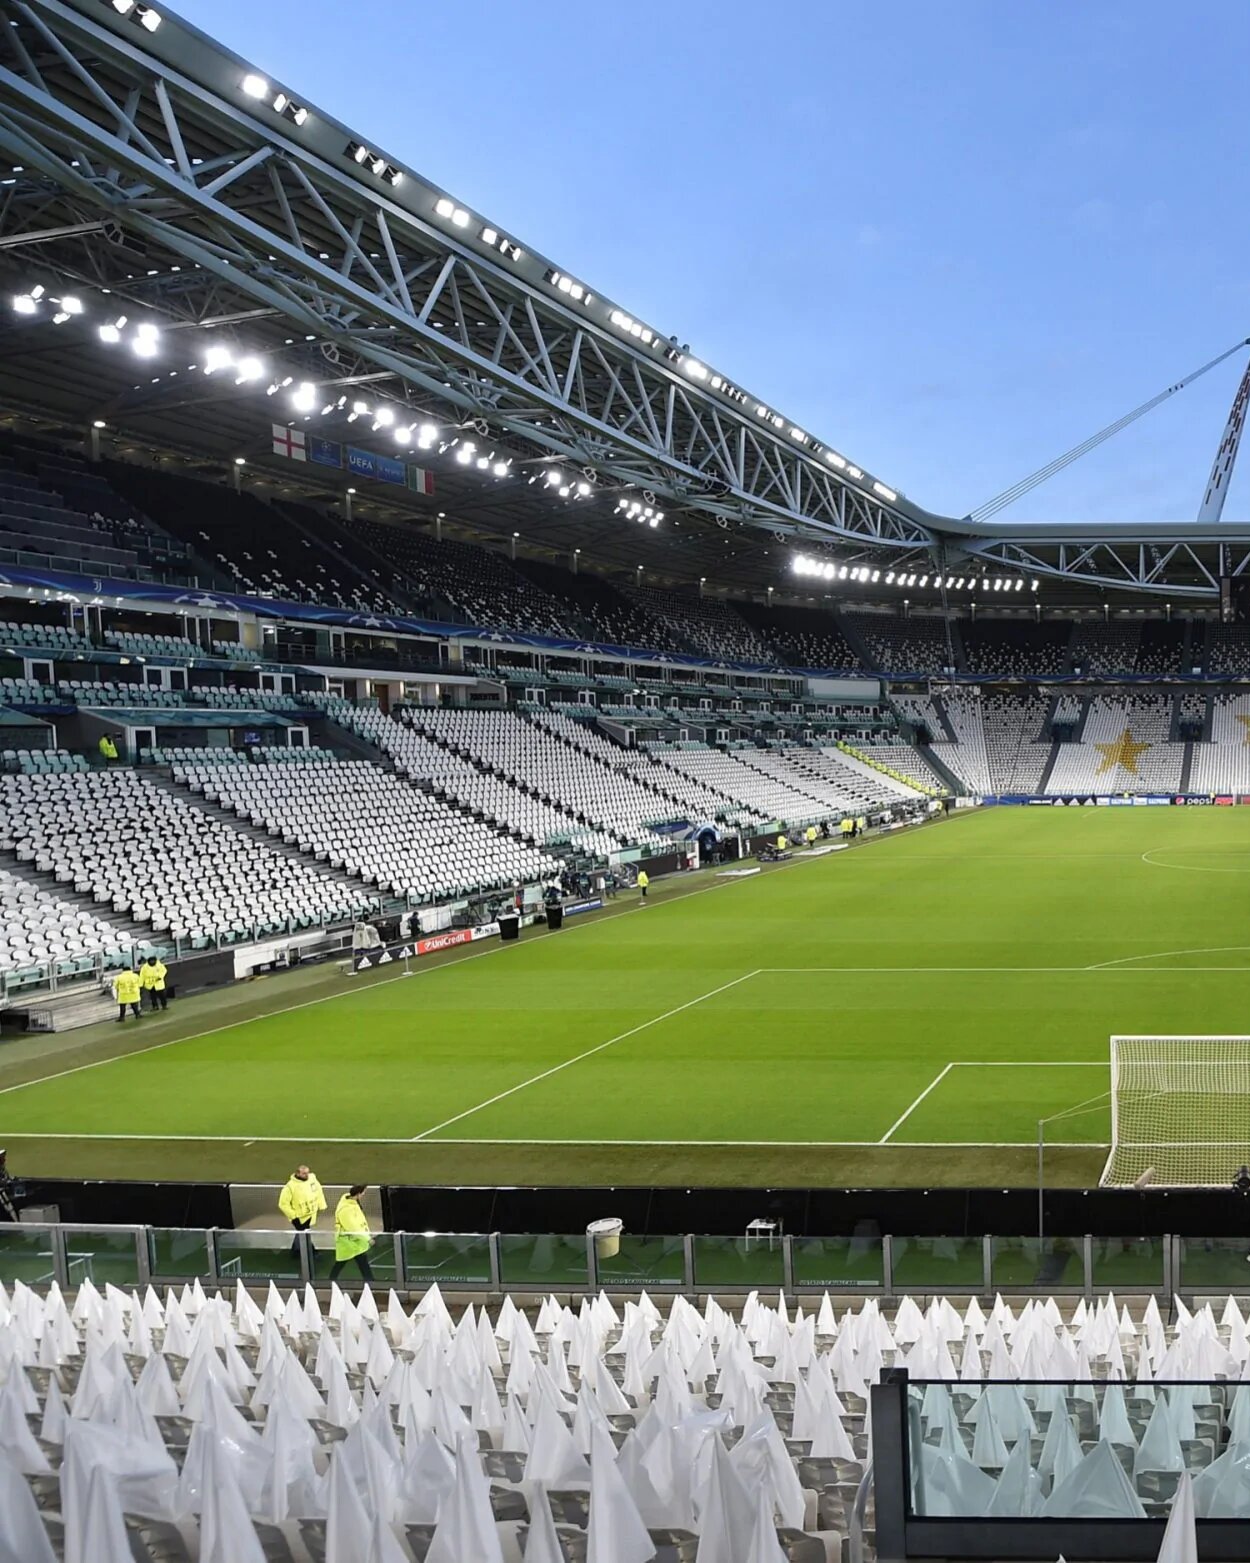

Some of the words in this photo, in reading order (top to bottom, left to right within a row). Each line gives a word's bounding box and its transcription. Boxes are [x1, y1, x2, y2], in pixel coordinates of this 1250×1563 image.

[349, 456, 373, 470] UEFA
[1187, 796, 1213, 805] pepsi
[431, 934, 465, 949] UniCredit
